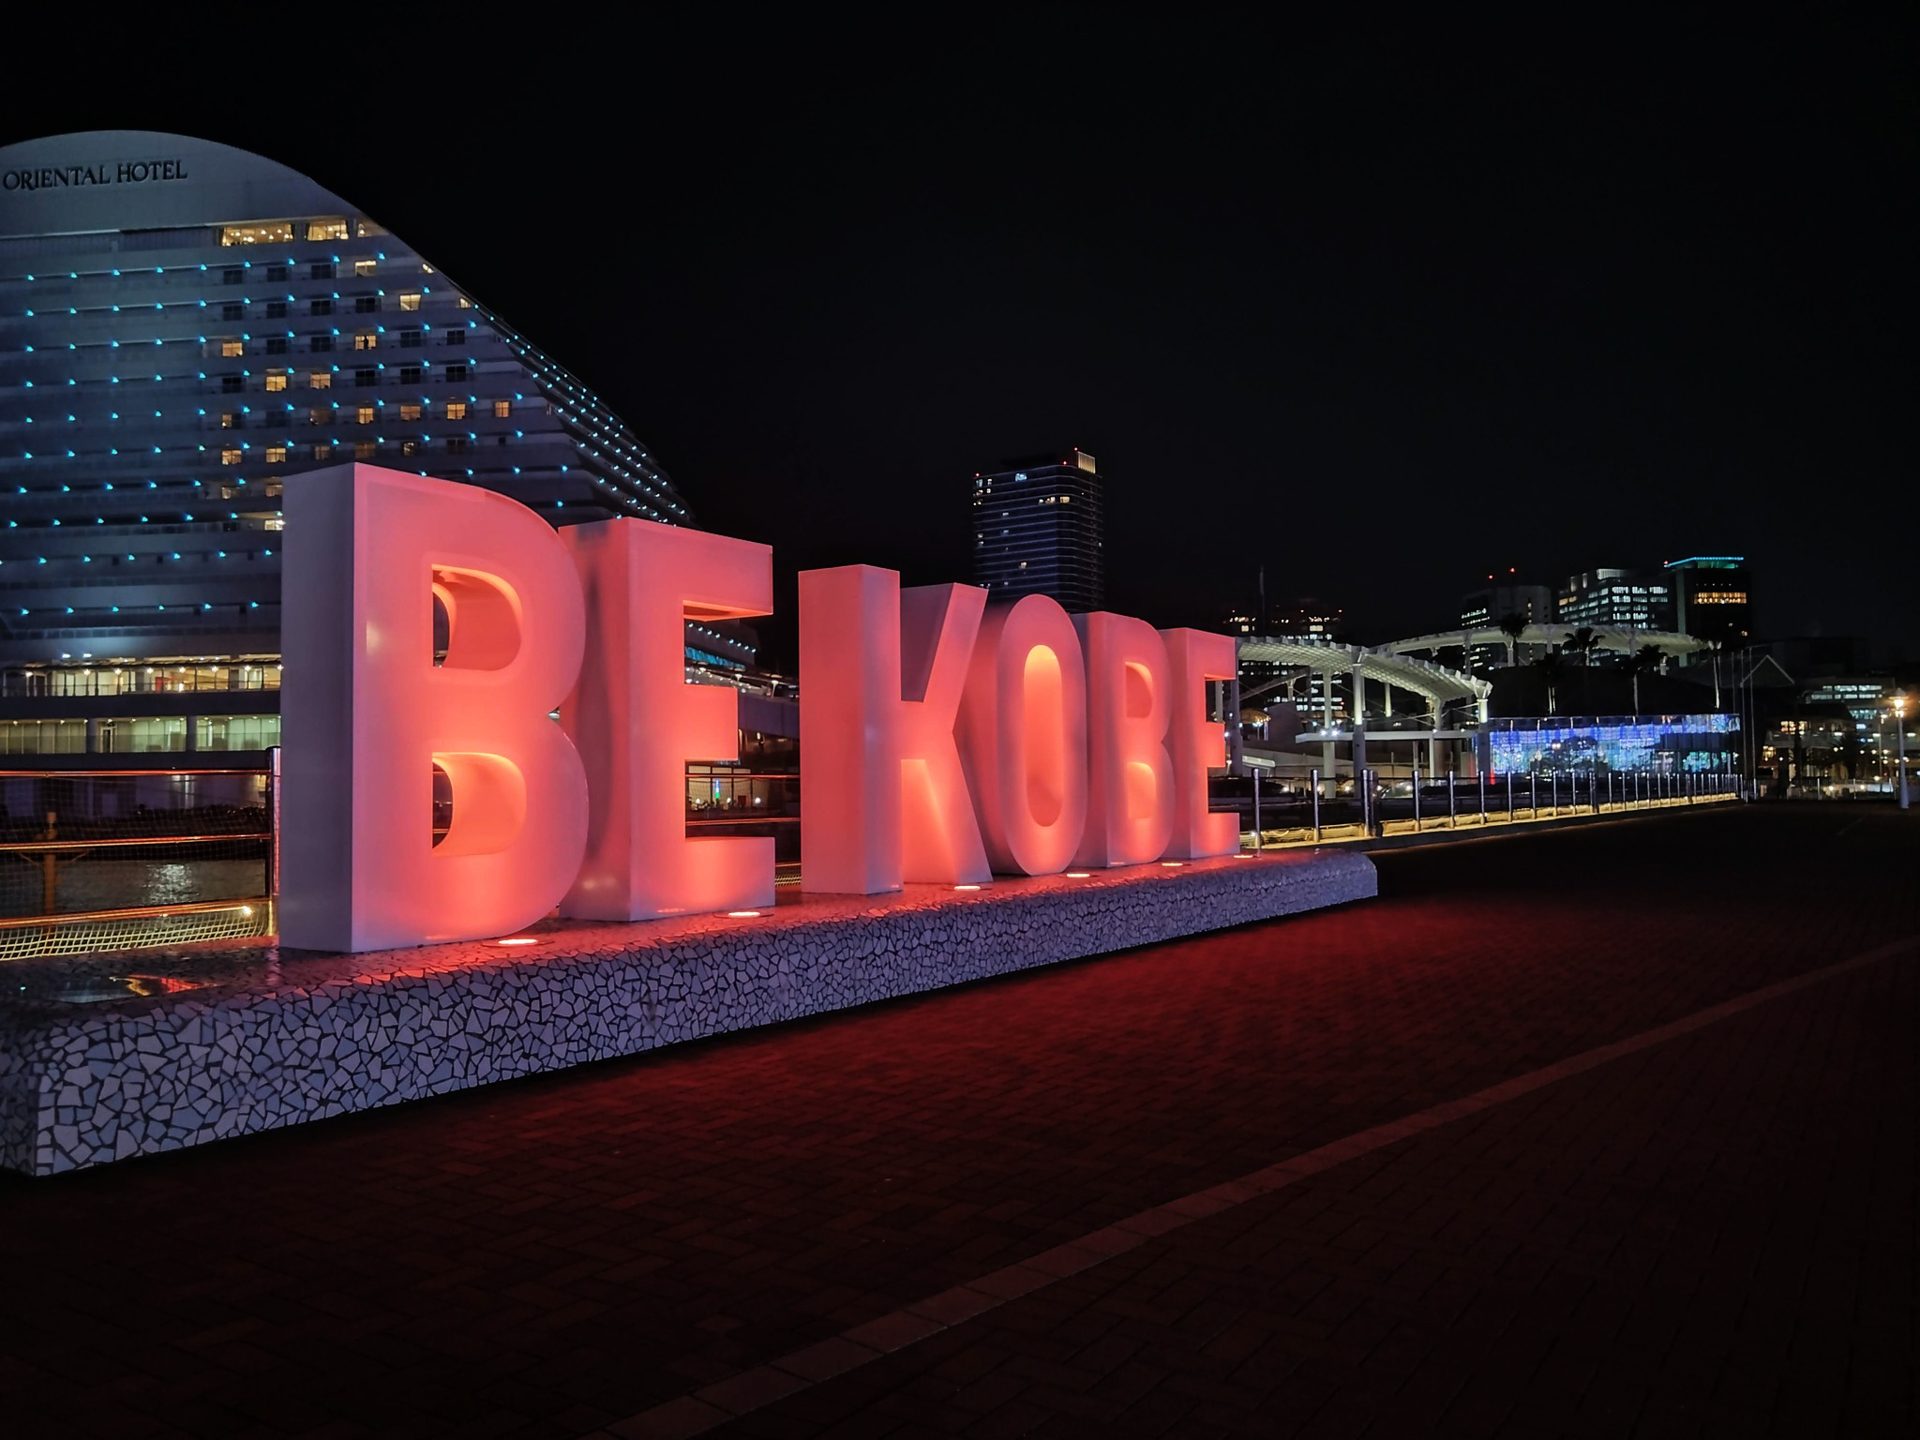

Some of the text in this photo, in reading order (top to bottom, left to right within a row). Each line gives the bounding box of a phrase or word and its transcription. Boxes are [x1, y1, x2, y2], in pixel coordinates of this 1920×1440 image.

[3, 160, 188, 191] ORIENTAL HOTEL
[281, 462, 1240, 953] BE KOBE
